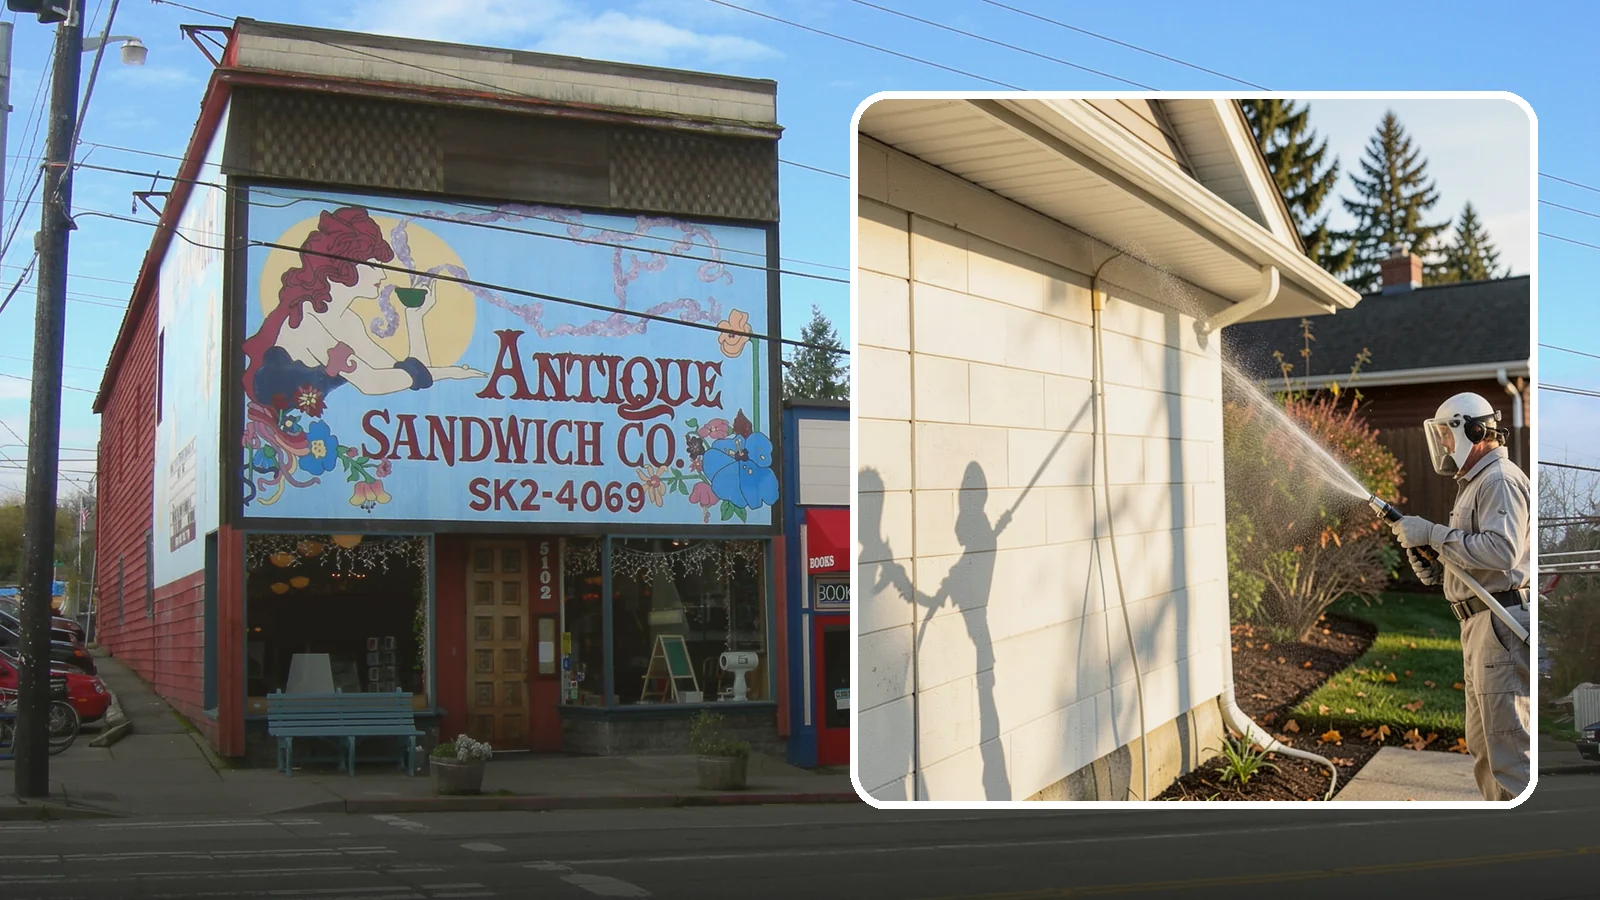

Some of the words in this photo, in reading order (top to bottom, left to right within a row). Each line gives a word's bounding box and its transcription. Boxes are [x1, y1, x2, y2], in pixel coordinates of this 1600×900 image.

[476, 329, 724, 421] ANTIQUE
[361, 408, 604, 467] SANDWICH
[617, 421, 685, 469] CO.
[468, 477, 645, 513] SK2-4069
[540, 541, 552, 600] 5102
[809, 554, 835, 569] BOOKS
